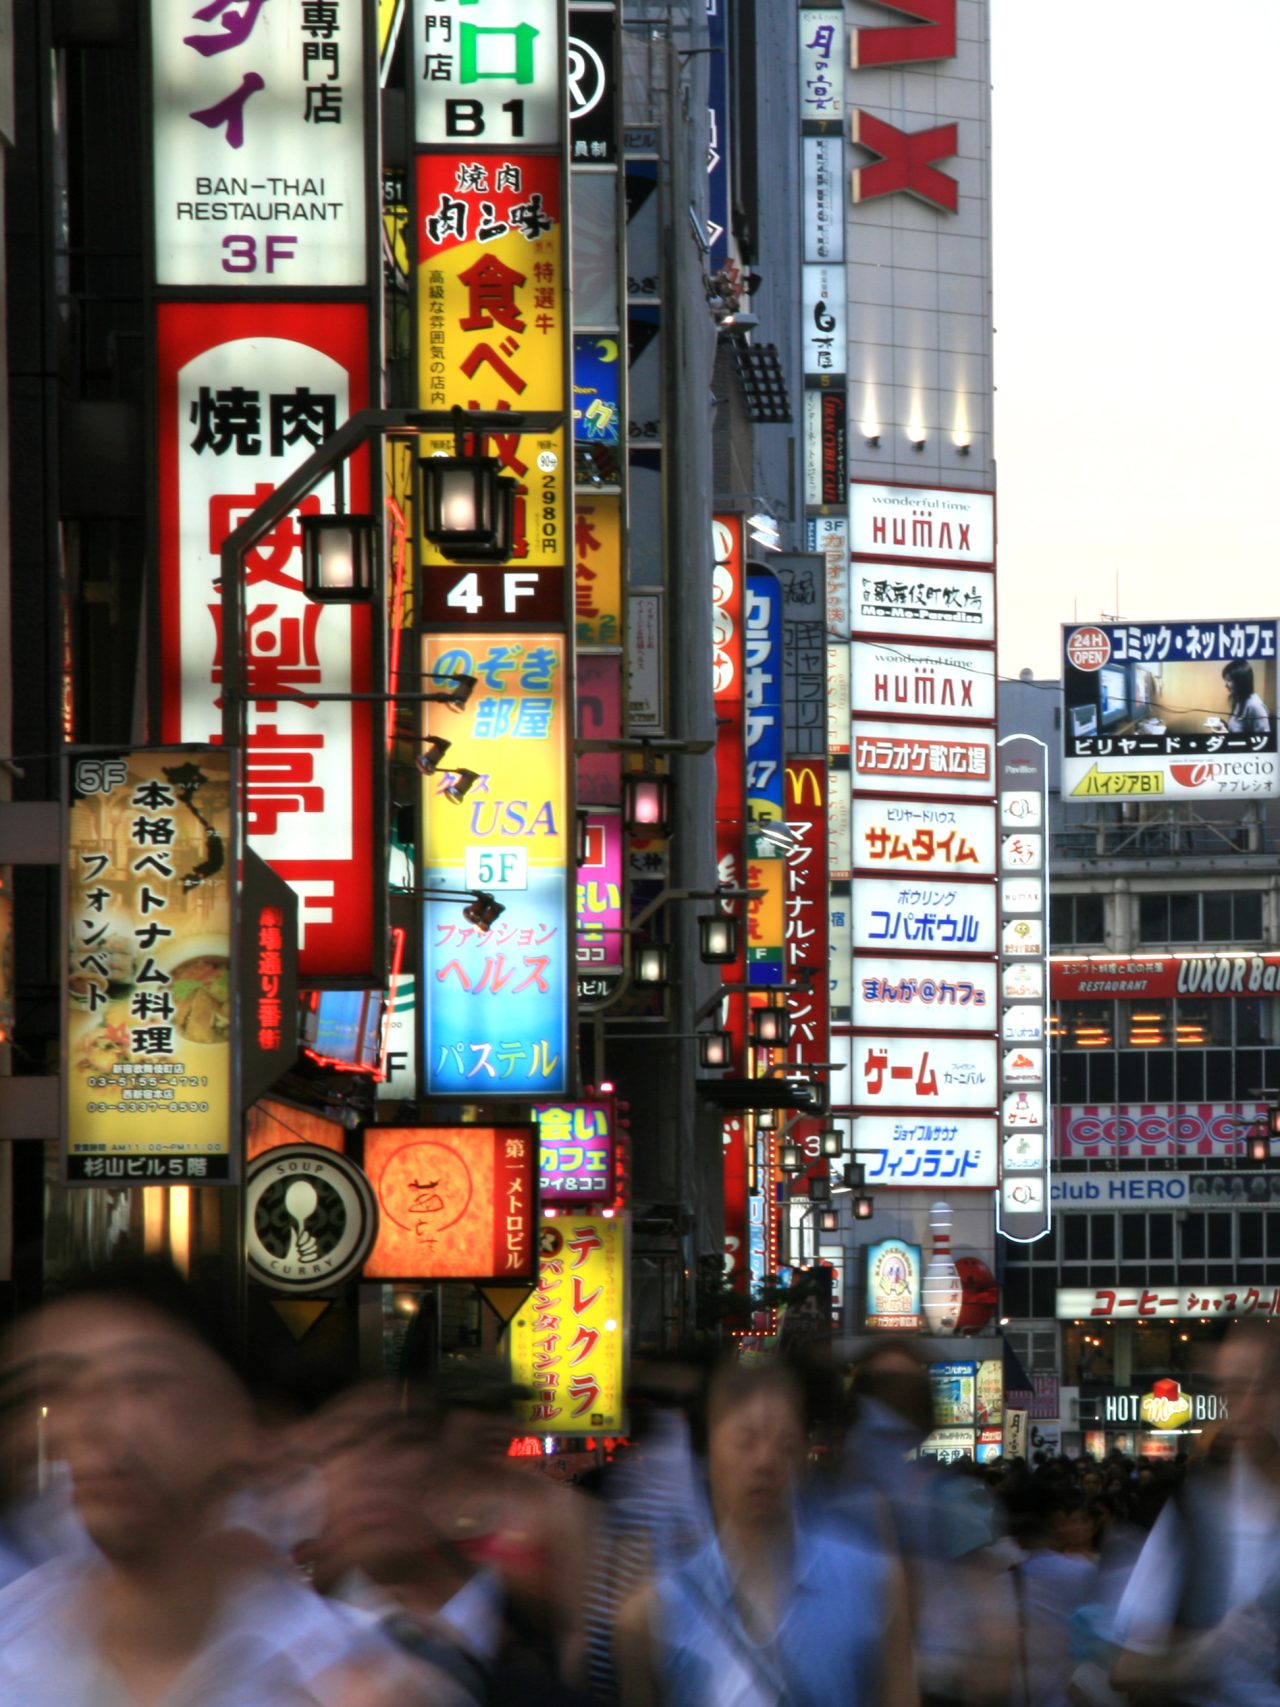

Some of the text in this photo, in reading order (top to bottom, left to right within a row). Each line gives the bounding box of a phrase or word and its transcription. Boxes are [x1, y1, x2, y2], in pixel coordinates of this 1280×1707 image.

[301, 0, 343, 125] 専門店
[445, 98, 525, 137] B1
[573, 140, 607, 157] 員制
[196, 177, 326, 196] BAN-THAI
[454, 163, 522, 193] 焼肉
[177, 202, 343, 220] RESTAURANT
[221, 235, 298, 273] 3F
[533, 262, 555, 334] 特選牛
[429, 270, 445, 404] 高級な雰囲気の店内
[190, 387, 336, 457] 焼肉
[542, 475, 557, 554] 2980円
[872, 495, 971, 511] wonderful time
[824, 520, 844, 532] 3F
[872, 510, 971, 551] HUMAX
[447, 573, 539, 613] 4F
[862, 605, 982, 624] Mo-Mo-Paradise
[1073, 634, 1102, 647] 24H
[1113, 624, 1274, 660] コミック・ネットカフェ
[432, 645, 559, 692] のぞき
[874, 653, 973, 670] wonderful time
[1074, 651, 1103, 664] OPEN
[874, 668, 973, 708] HUMAX
[473, 697, 554, 739] 部屋
[857, 741, 987, 774] カラオケ歌広場
[1075, 736, 1269, 755] ビリヤード・ダーツ
[77, 761, 127, 793] 5F
[1086, 774, 1161, 794] ハイジアB1
[1217, 779, 1273, 792] アプレシオ
[470, 800, 560, 836] USA
[887, 808, 957, 824] ビリヤードハウス
[865, 826, 979, 864] サムタイム
[478, 853, 518, 883] 5F
[897, 889, 957, 906] ボウリング
[131, 781, 175, 1055] 本格ベトナム料理
[868, 910, 979, 942] コパボウル
[435, 923, 558, 948] ファッション
[436, 953, 551, 994] ヘルス
[1078, 980, 1147, 992] RESTAURANT
[1177, 958, 1246, 994] LUXOR
[862, 977, 986, 1006] まんが@カフェ
[434, 1039, 559, 1079] パステル
[864, 1048, 938, 1095] ゲーム
[943, 1072, 985, 1086] カーニバル
[532, 1106, 608, 1142] 会い
[893, 1125, 958, 1141] ジョイフルサウナ
[1008, 1113, 1038, 1124] ゲーム
[84, 1158, 207, 1178] 杉山ビル5階
[275, 1160, 325, 1176] SOUP
[869, 1149, 980, 1177] フィンランド
[1050, 1176, 1186, 1199] club HERO
[505, 1139, 525, 1269] 第一メトロビル
[270, 1258, 334, 1276] CURRY
[567, 1226, 603, 1419] テレクラ
[1106, 1396, 1138, 1421] HOT
[1196, 1396, 1229, 1421] BOX
